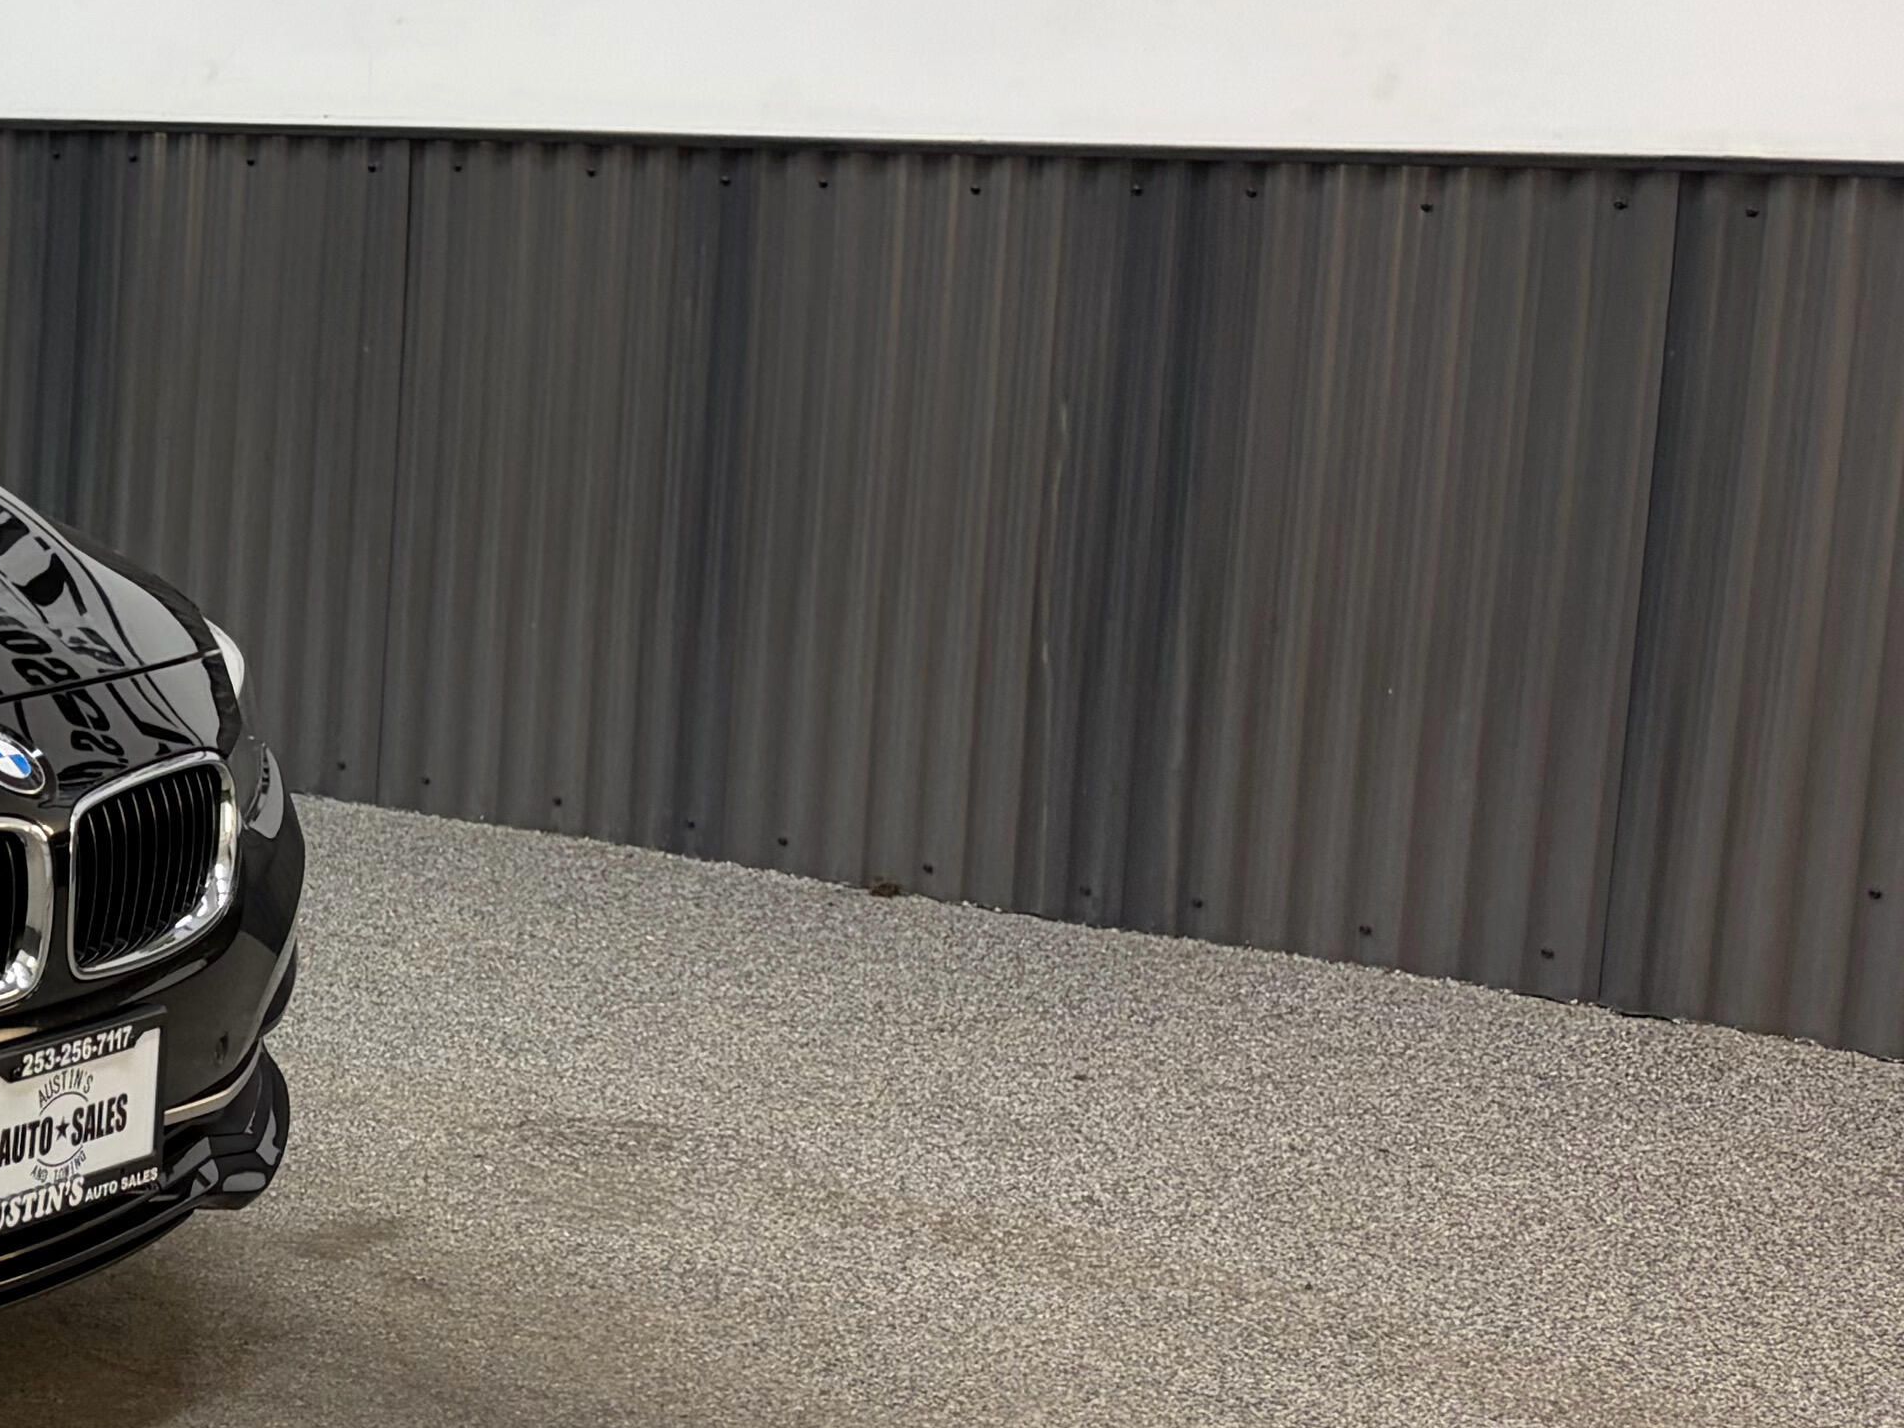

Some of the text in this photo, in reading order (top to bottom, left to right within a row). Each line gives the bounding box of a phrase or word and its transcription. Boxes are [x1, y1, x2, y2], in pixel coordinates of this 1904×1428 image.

[21, 1025, 133, 1078] 253-256-7117
[38, 1068, 94, 1108] AUSTIN'S
[71, 1093, 128, 1147] SALES
[85, 1180, 118, 1203] AUTO
[120, 1167, 159, 1191] SALES
